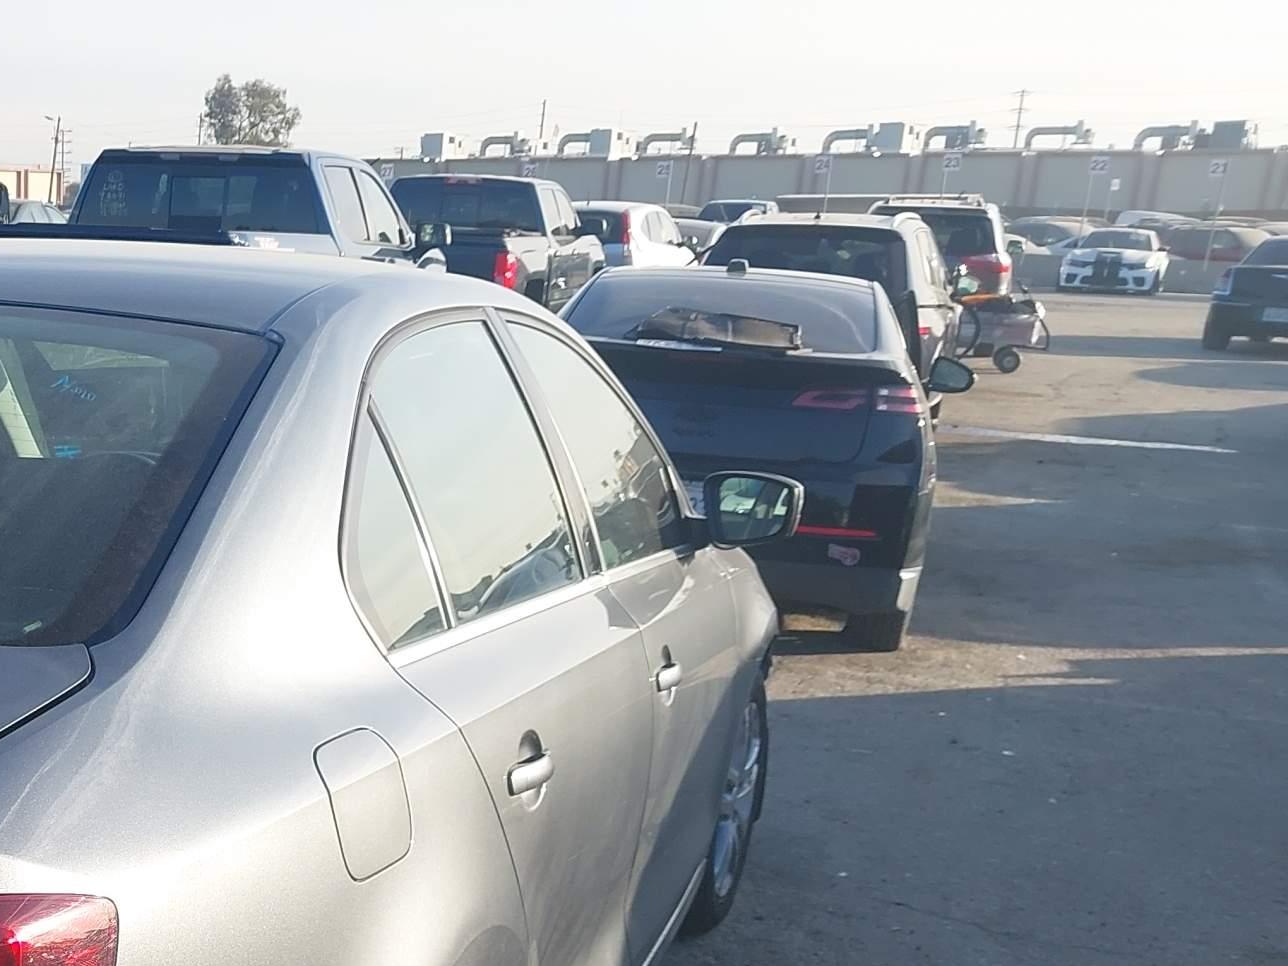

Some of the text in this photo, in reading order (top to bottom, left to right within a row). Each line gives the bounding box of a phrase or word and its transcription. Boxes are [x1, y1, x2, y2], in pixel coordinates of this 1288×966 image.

[944, 157, 959, 169] 23
[1091, 159, 1108, 171] 22
[1210, 163, 1227, 175] 21
[381, 166, 393, 178] 27
